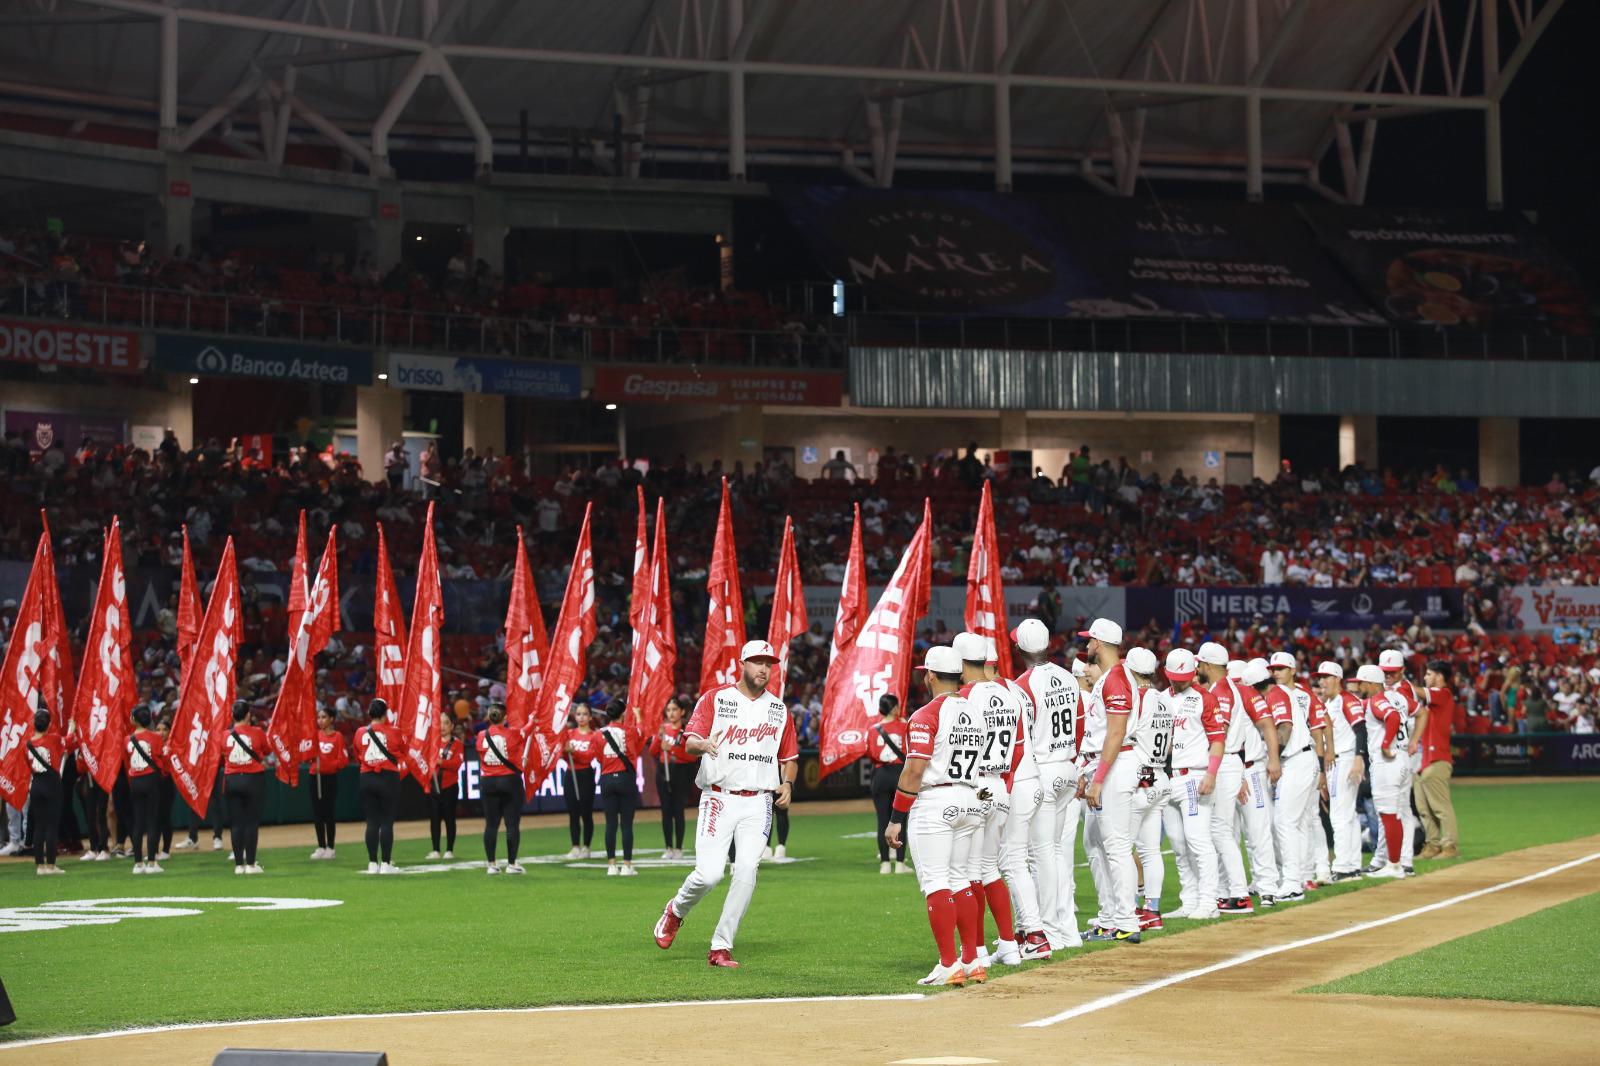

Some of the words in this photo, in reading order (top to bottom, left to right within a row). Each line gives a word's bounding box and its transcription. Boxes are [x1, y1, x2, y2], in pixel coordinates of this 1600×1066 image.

[908, 233, 958, 249] LA
[847, 251, 1052, 285] MAREA
[1220, 261, 1292, 275] TODOS
[231, 355, 284, 377] Banco
[288, 358, 349, 382] Azteca
[623, 373, 719, 400] Gaspasa
[731, 379, 786, 390] SIEMPRE
[1212, 595, 1291, 613] HERSA
[718, 698, 738, 707] Mobil
[1051, 708, 1072, 738] 88
[728, 752, 746, 761] Red
[982, 730, 1011, 760] 79
[1152, 732, 1168, 757] 91
[948, 750, 978, 780] 57
